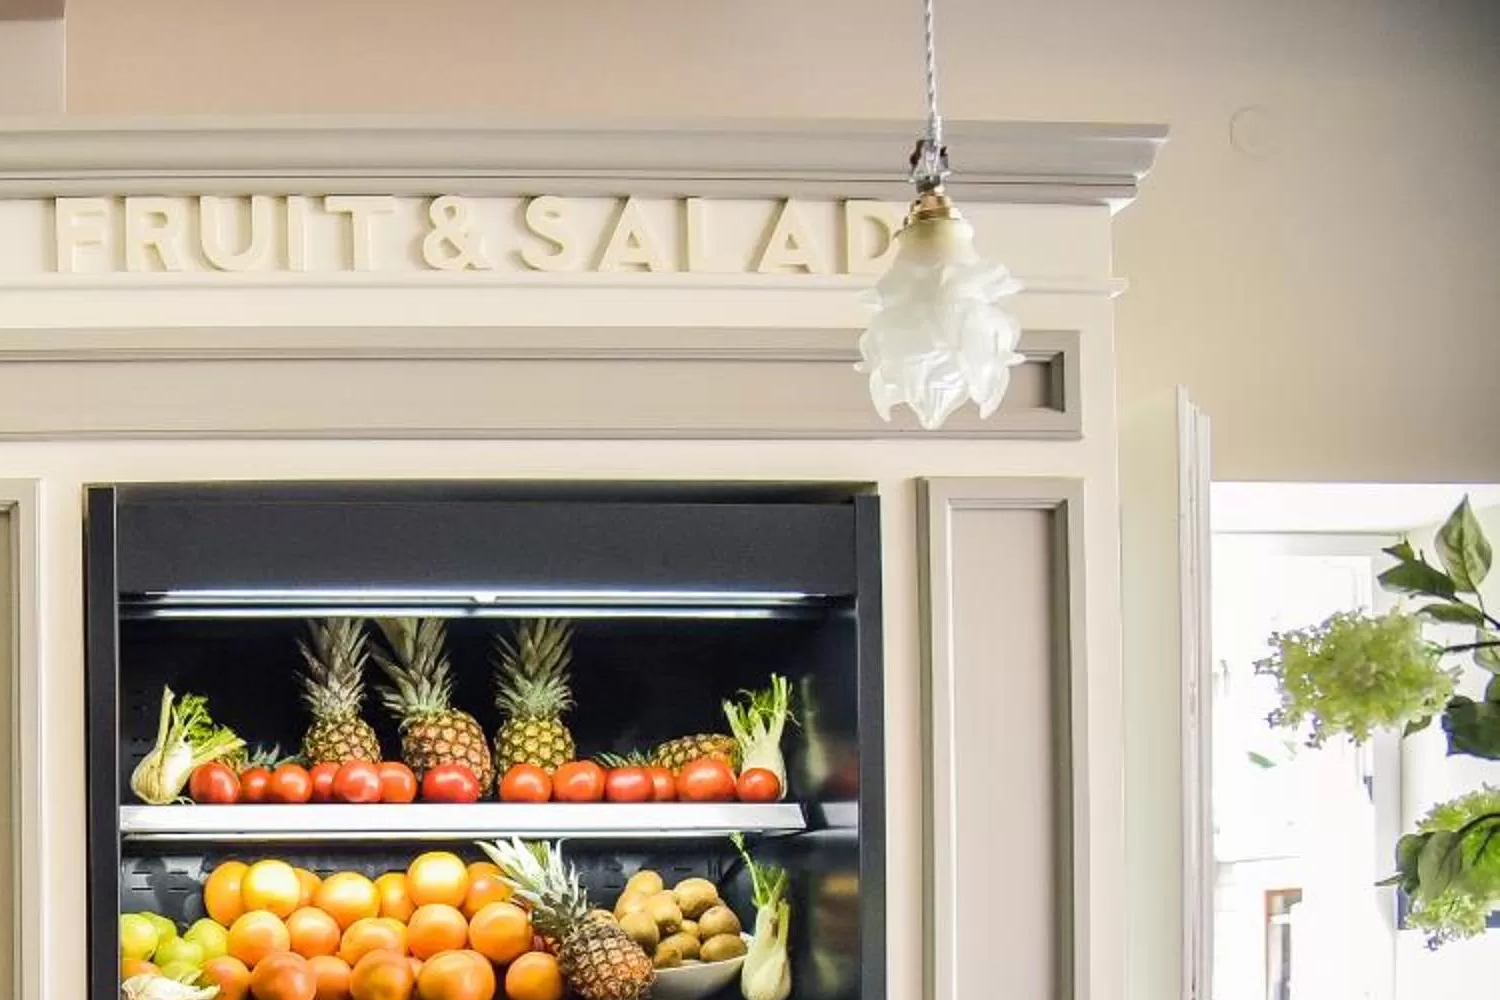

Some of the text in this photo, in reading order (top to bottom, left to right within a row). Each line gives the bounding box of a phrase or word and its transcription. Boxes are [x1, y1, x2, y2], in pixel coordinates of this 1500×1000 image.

[55, 194, 901, 274] FRUIT & SALAD
